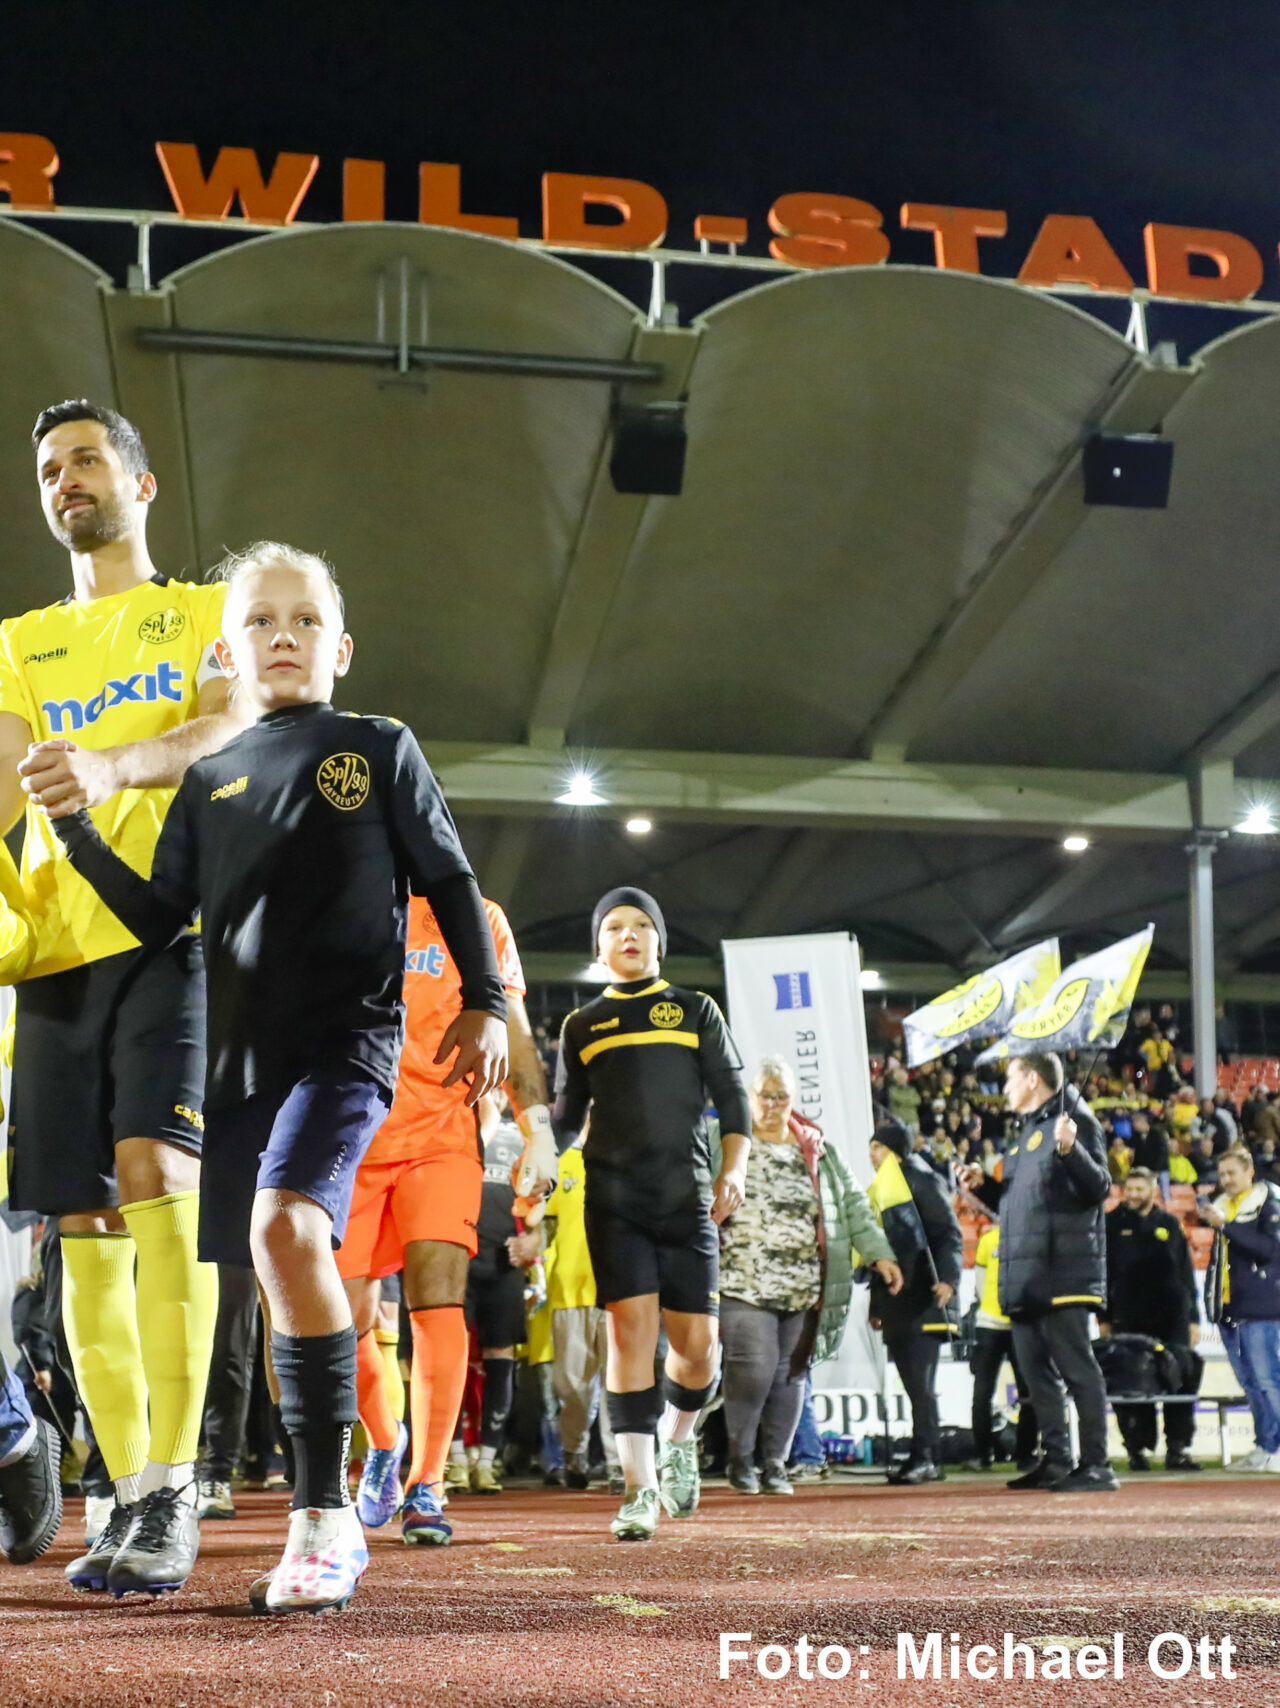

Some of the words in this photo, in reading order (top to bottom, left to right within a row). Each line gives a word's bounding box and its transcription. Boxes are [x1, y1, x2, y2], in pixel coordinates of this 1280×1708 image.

[155, 140, 1280, 301] WILD-STAD
[23, 646, 68, 665] capelli
[41, 661, 183, 733] maxit
[321, 756, 367, 795] SpVgg
[322, 782, 362, 807] BAYREUTH
